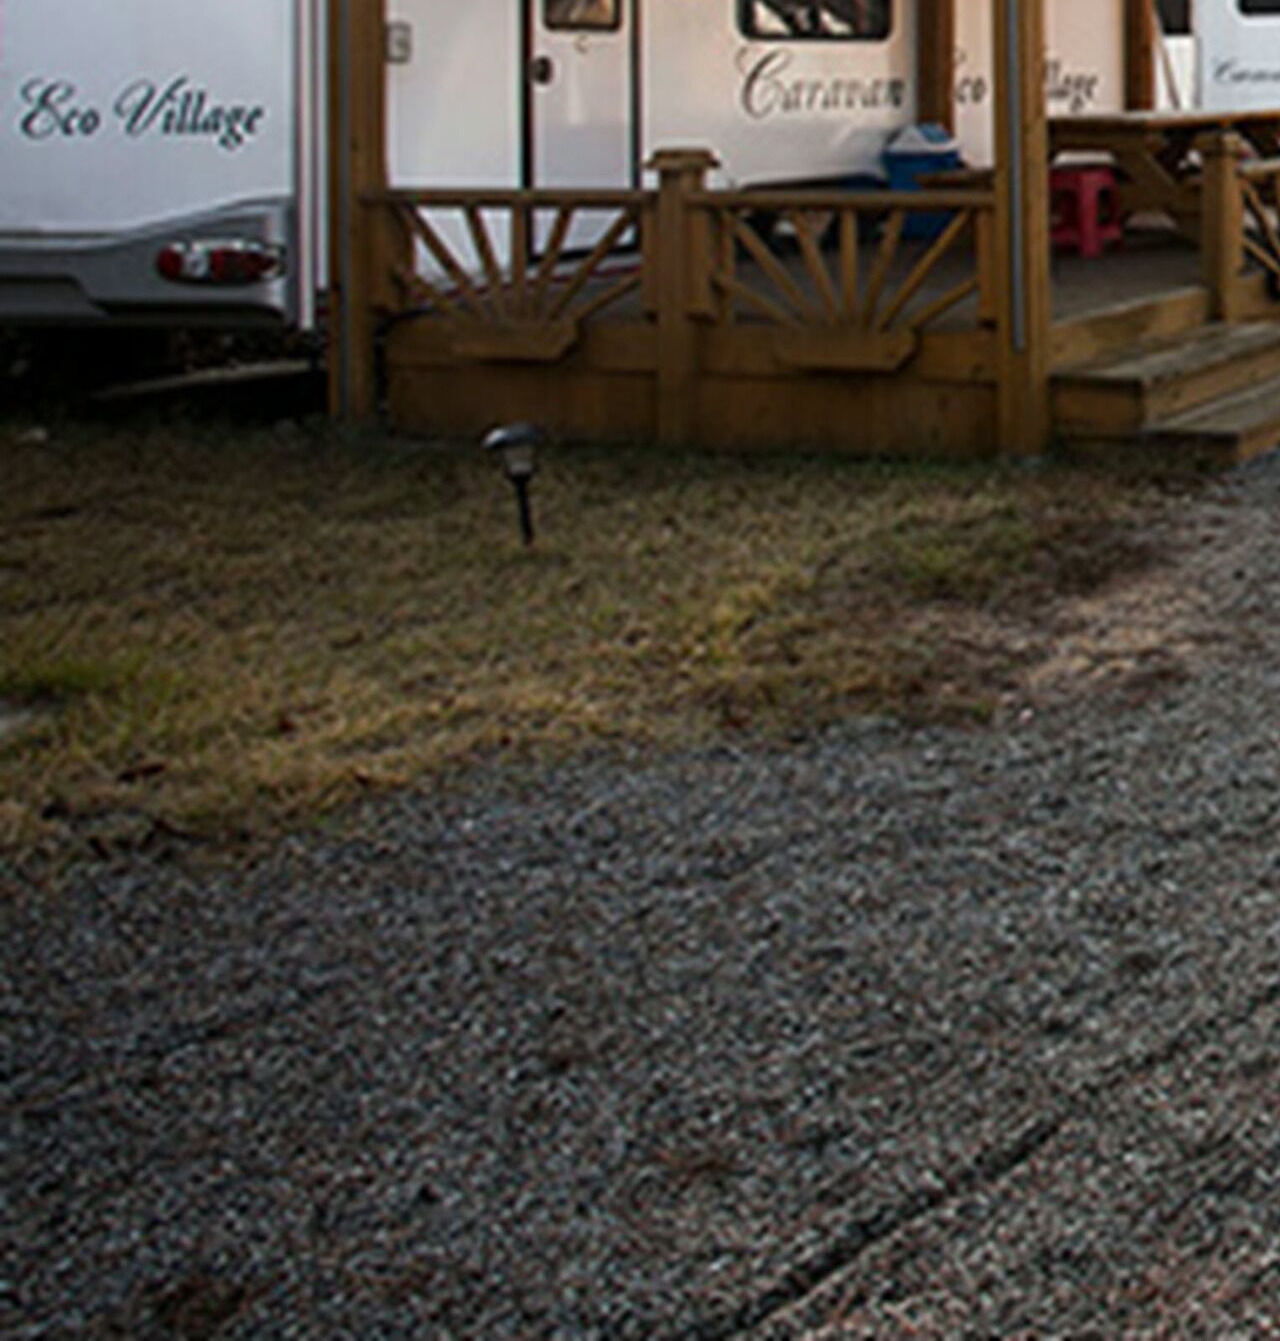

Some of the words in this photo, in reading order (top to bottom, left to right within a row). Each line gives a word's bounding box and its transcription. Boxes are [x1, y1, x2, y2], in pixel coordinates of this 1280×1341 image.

[20, 77, 101, 141] Eco
[112, 75, 265, 152] Village
[735, 47, 906, 119] Caravan
